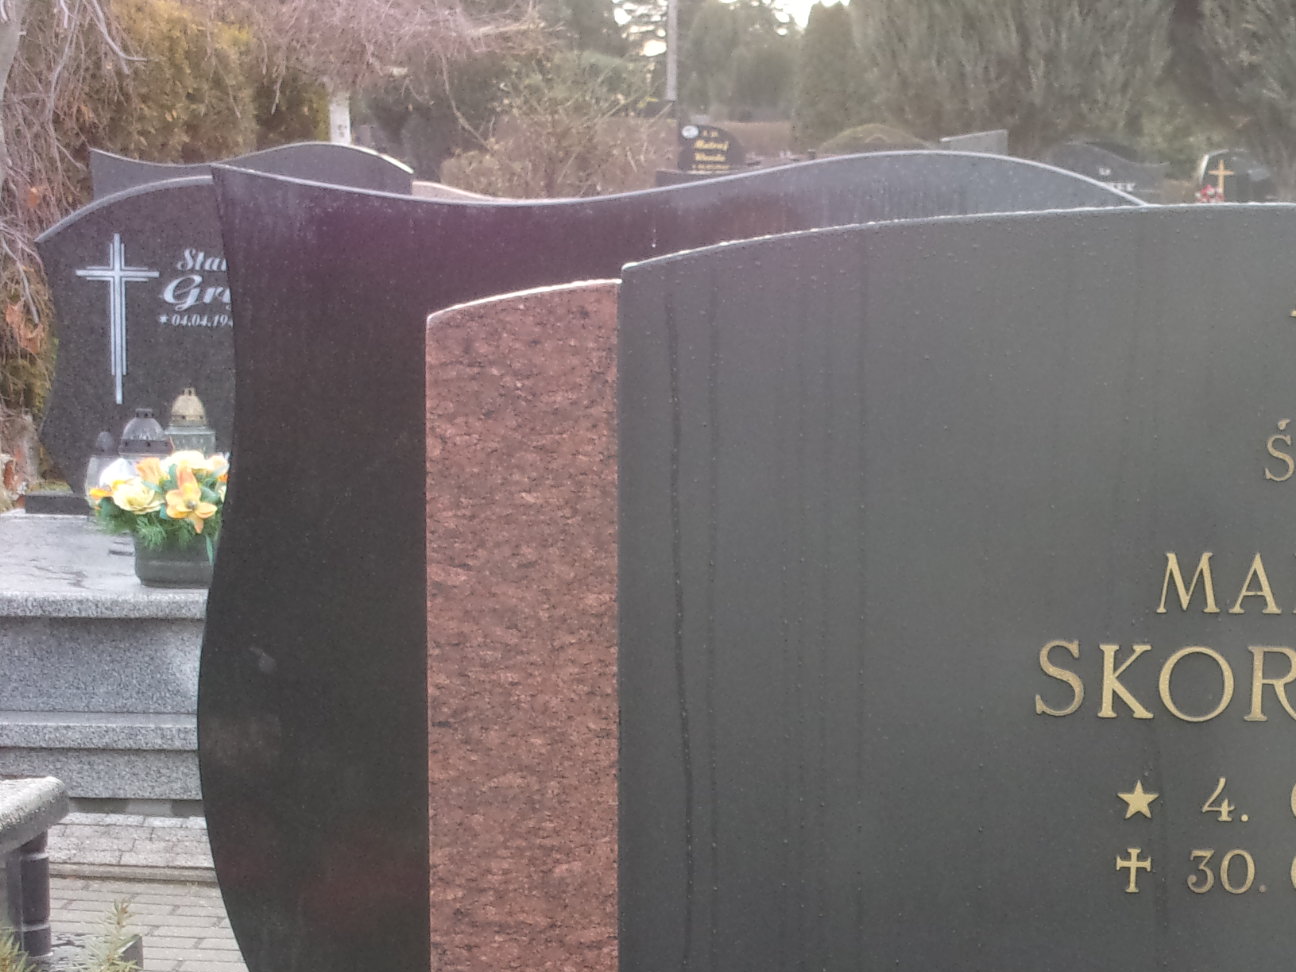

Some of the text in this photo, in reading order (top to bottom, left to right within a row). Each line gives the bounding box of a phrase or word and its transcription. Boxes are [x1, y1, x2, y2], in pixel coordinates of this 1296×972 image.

[1265, 419, 1295, 482] Ś
[1201, 777, 1249, 823] 4.
[1187, 848, 1267, 894] 30.
